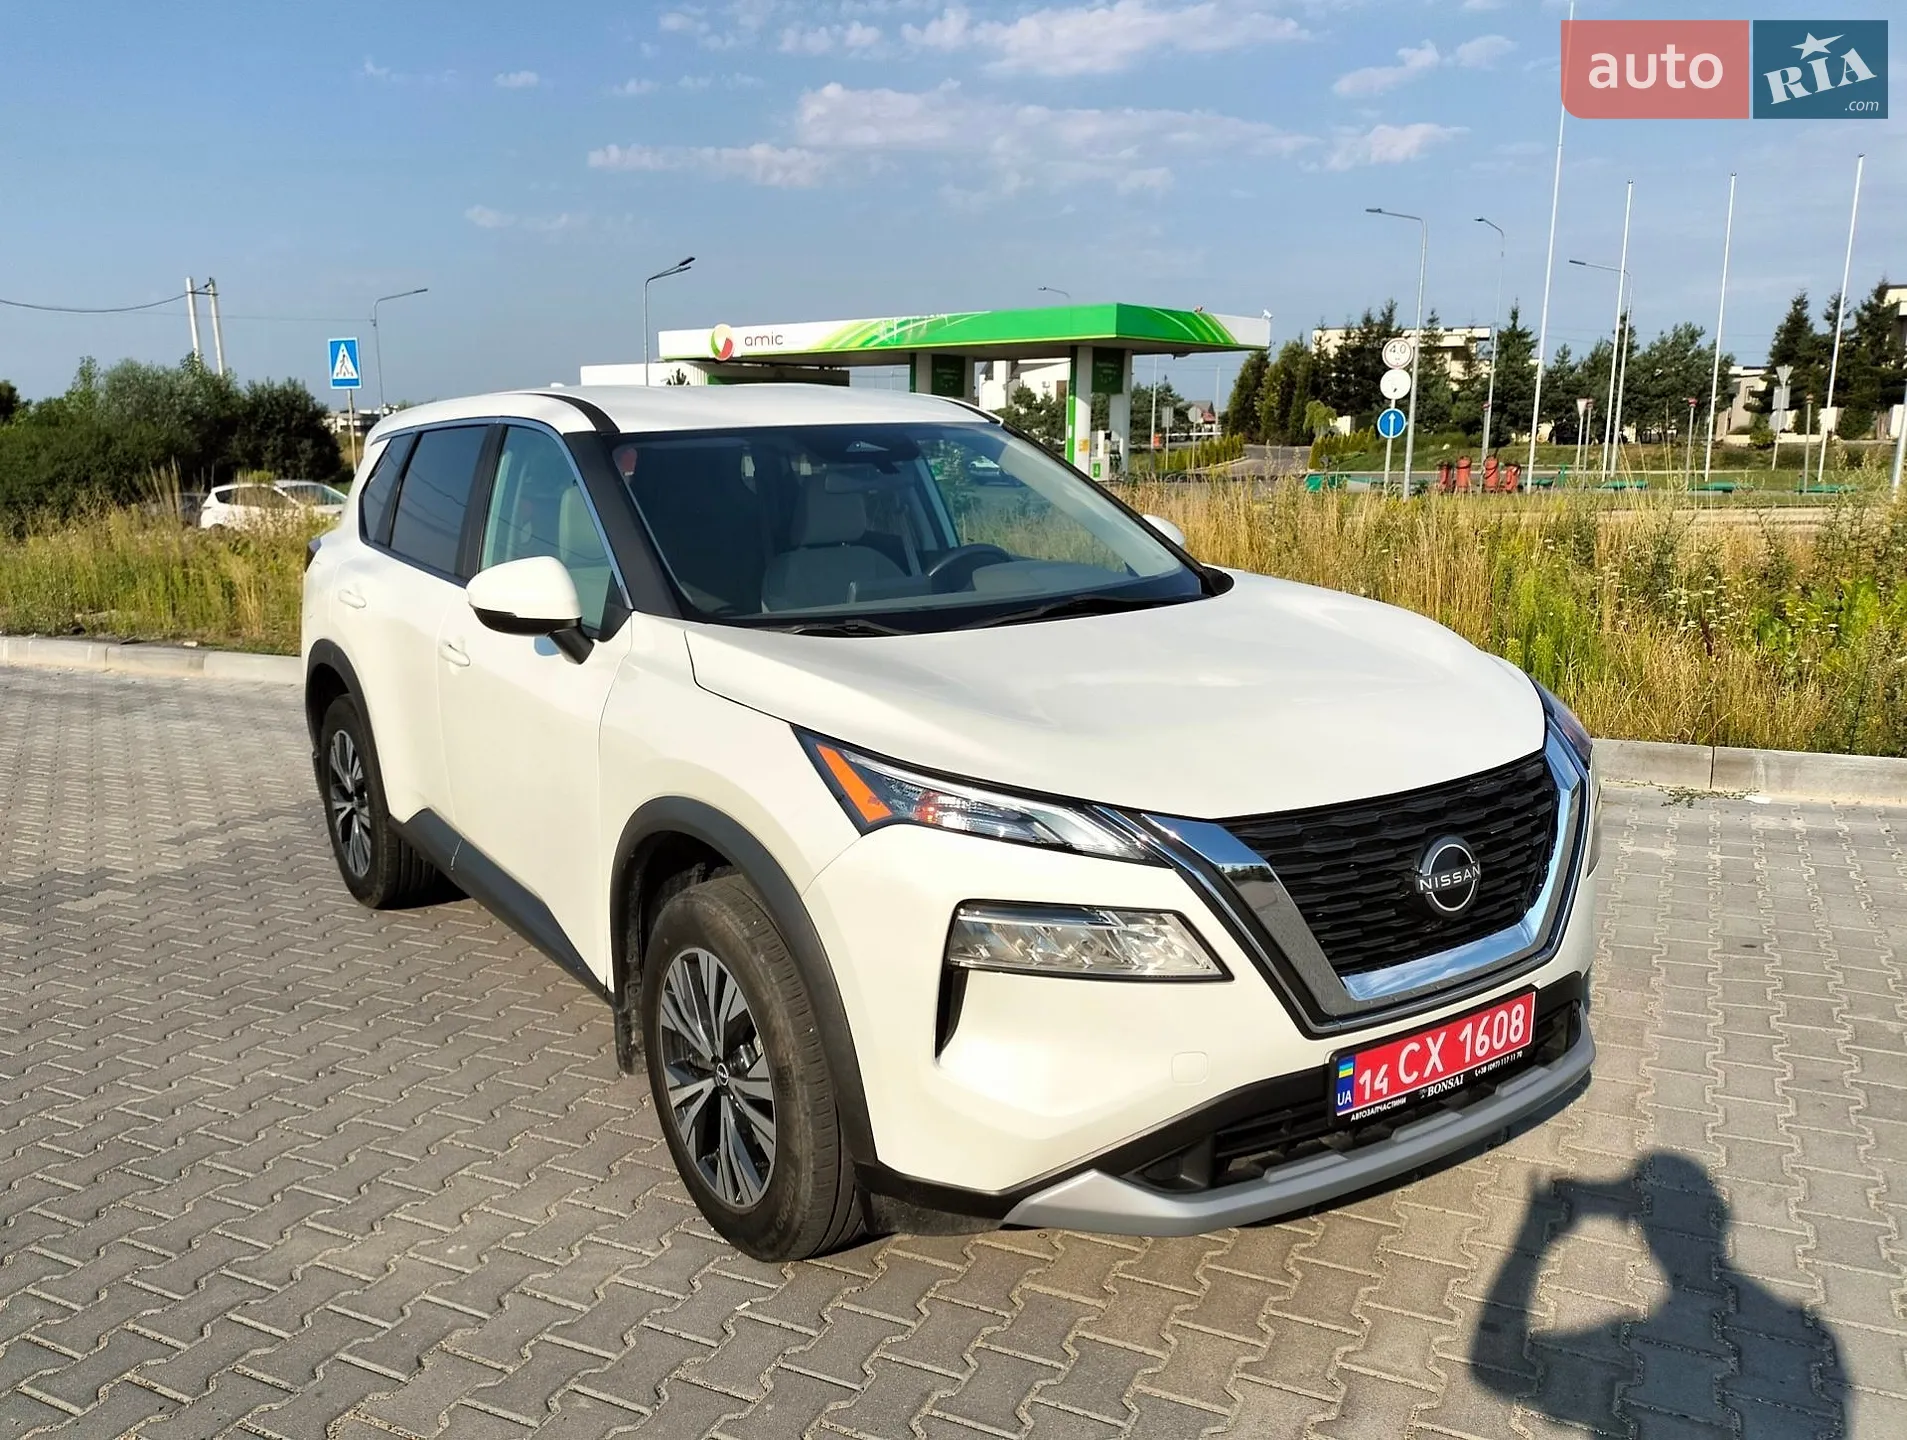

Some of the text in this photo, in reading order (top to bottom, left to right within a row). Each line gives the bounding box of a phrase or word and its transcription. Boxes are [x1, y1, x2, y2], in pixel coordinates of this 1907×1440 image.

[744, 332, 783, 347] amic
[1419, 863, 1480, 891] NISSAN
[1359, 1003, 1525, 1100] 14 CX 1608
[1427, 1074, 1464, 1097] BONSAI
[1337, 1089, 1352, 1106] UA
